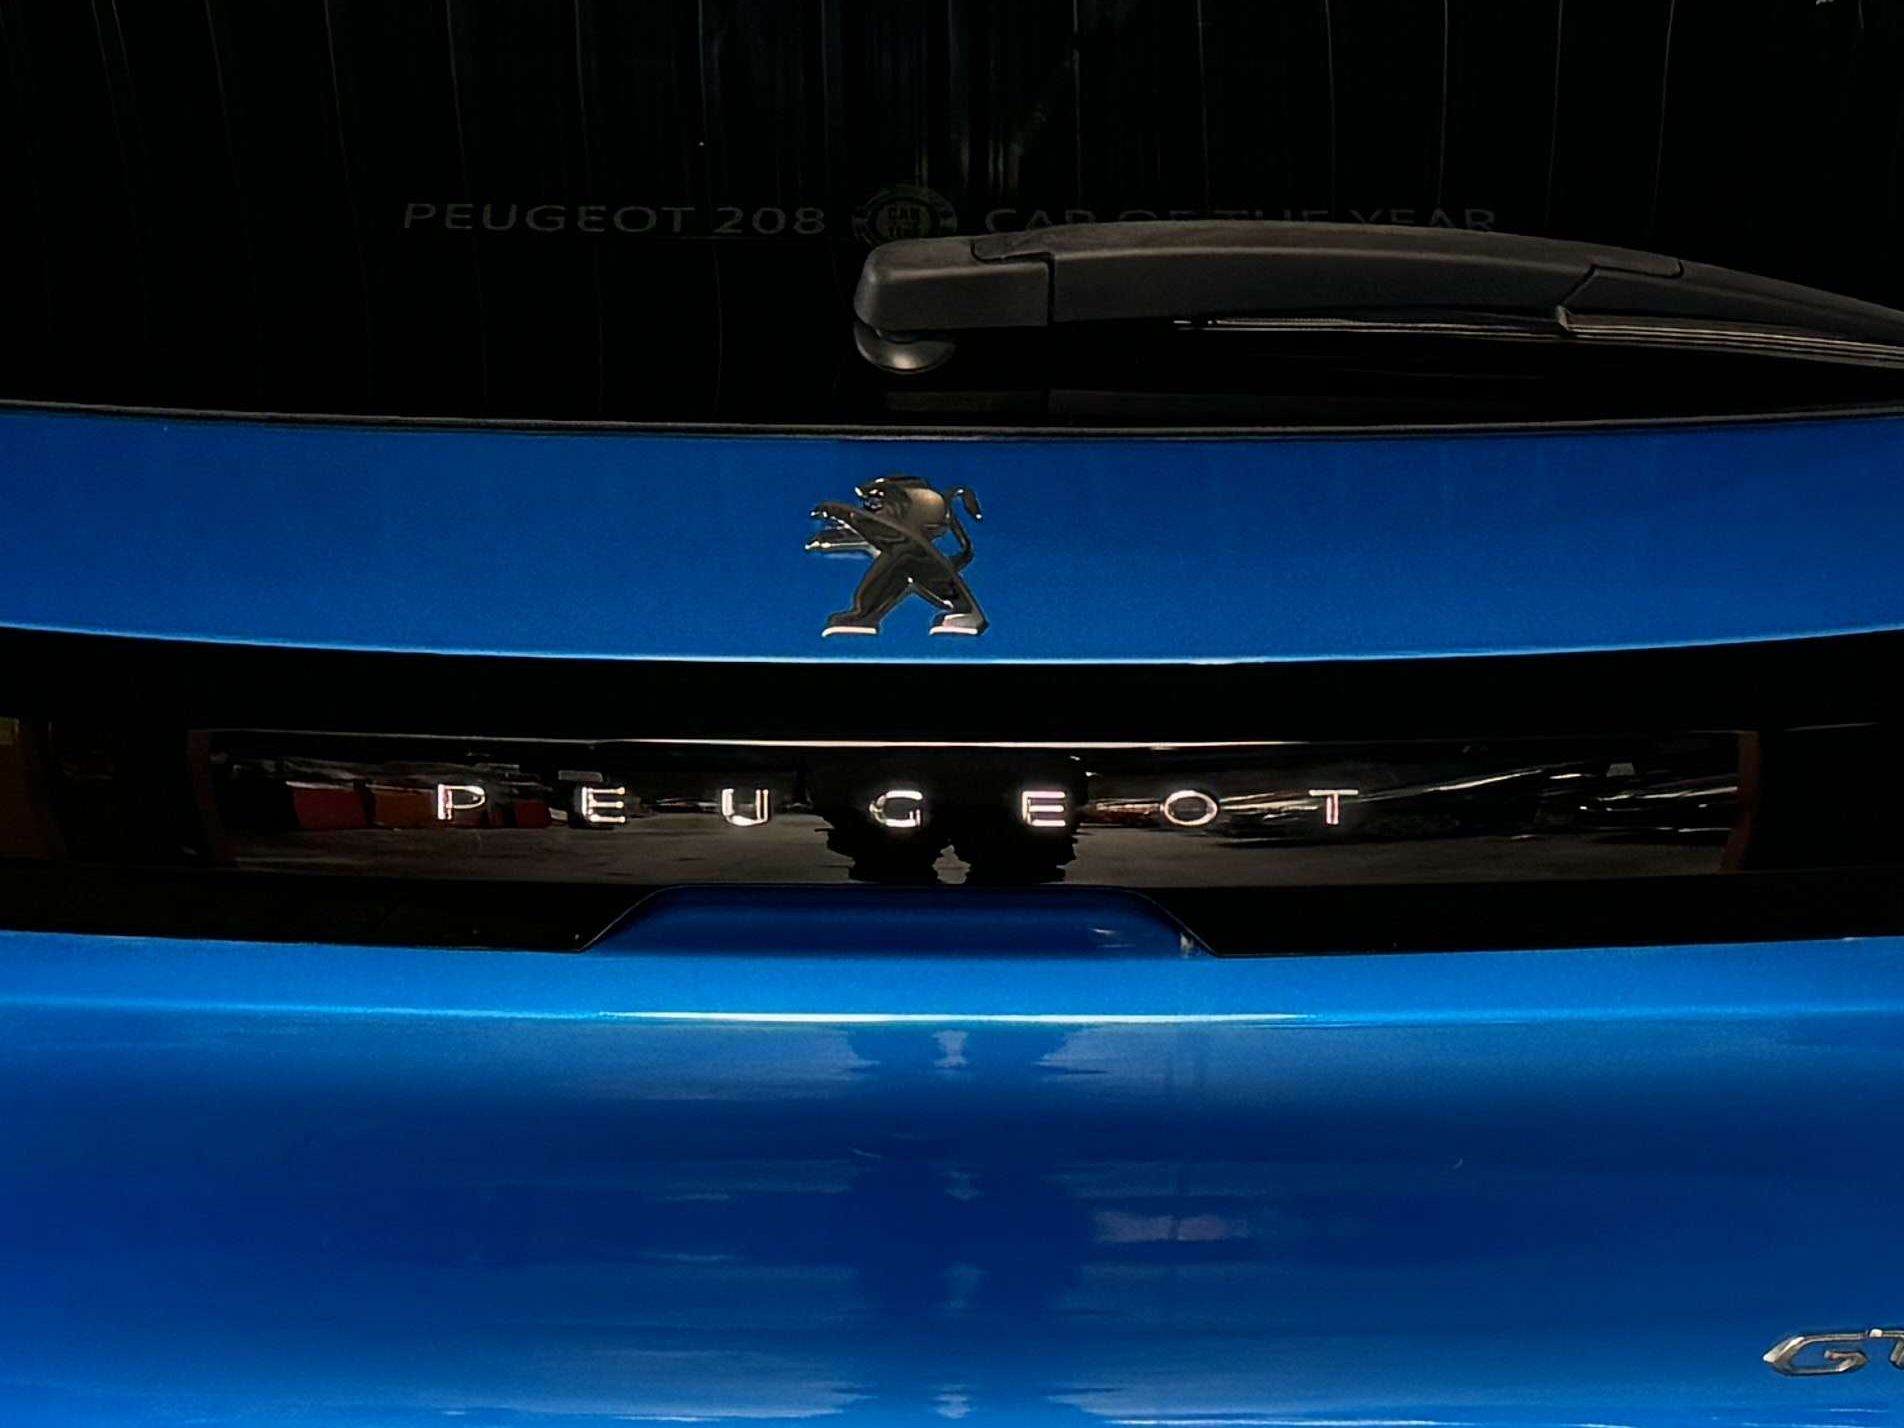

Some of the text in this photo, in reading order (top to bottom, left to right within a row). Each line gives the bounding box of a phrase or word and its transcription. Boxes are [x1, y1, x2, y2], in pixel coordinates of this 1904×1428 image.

[403, 202, 825, 236] PEUGEOT 208
[437, 783, 1360, 825] PEUGEOT
